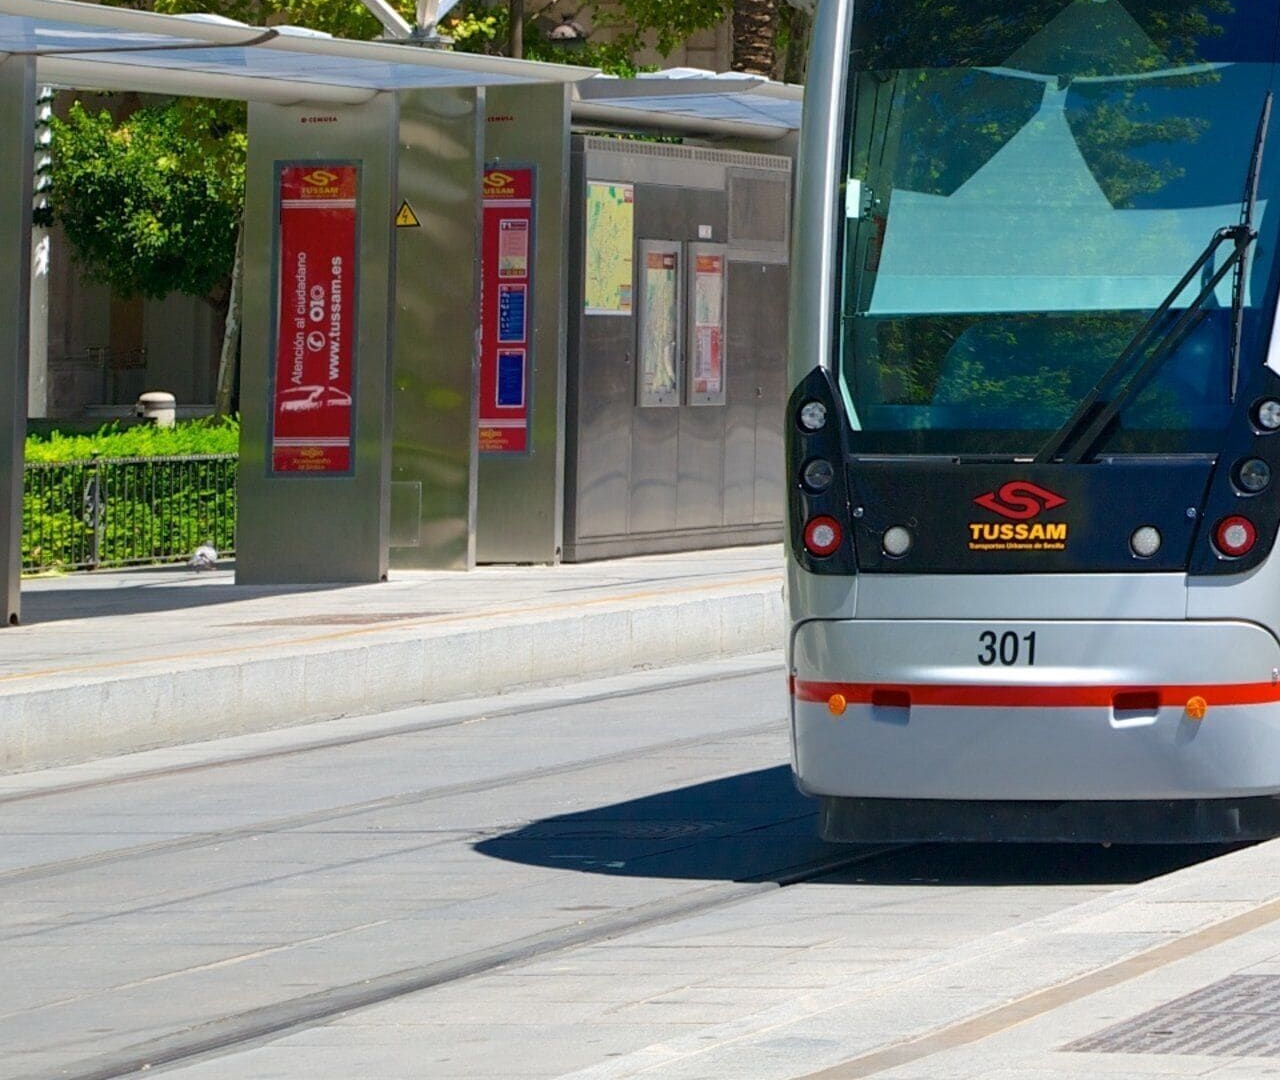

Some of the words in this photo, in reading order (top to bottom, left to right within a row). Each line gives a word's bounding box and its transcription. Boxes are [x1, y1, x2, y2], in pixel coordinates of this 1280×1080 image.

[302, 186, 339, 195] TUSSAM
[294, 251, 307, 315] ciudadano
[309, 284, 325, 323] 010
[328, 255, 343, 381] www.tussam.es
[294, 317, 306, 329] al
[291, 331, 306, 385] Atención
[969, 522, 1068, 540] TUSSAM
[977, 630, 1036, 666] 301
